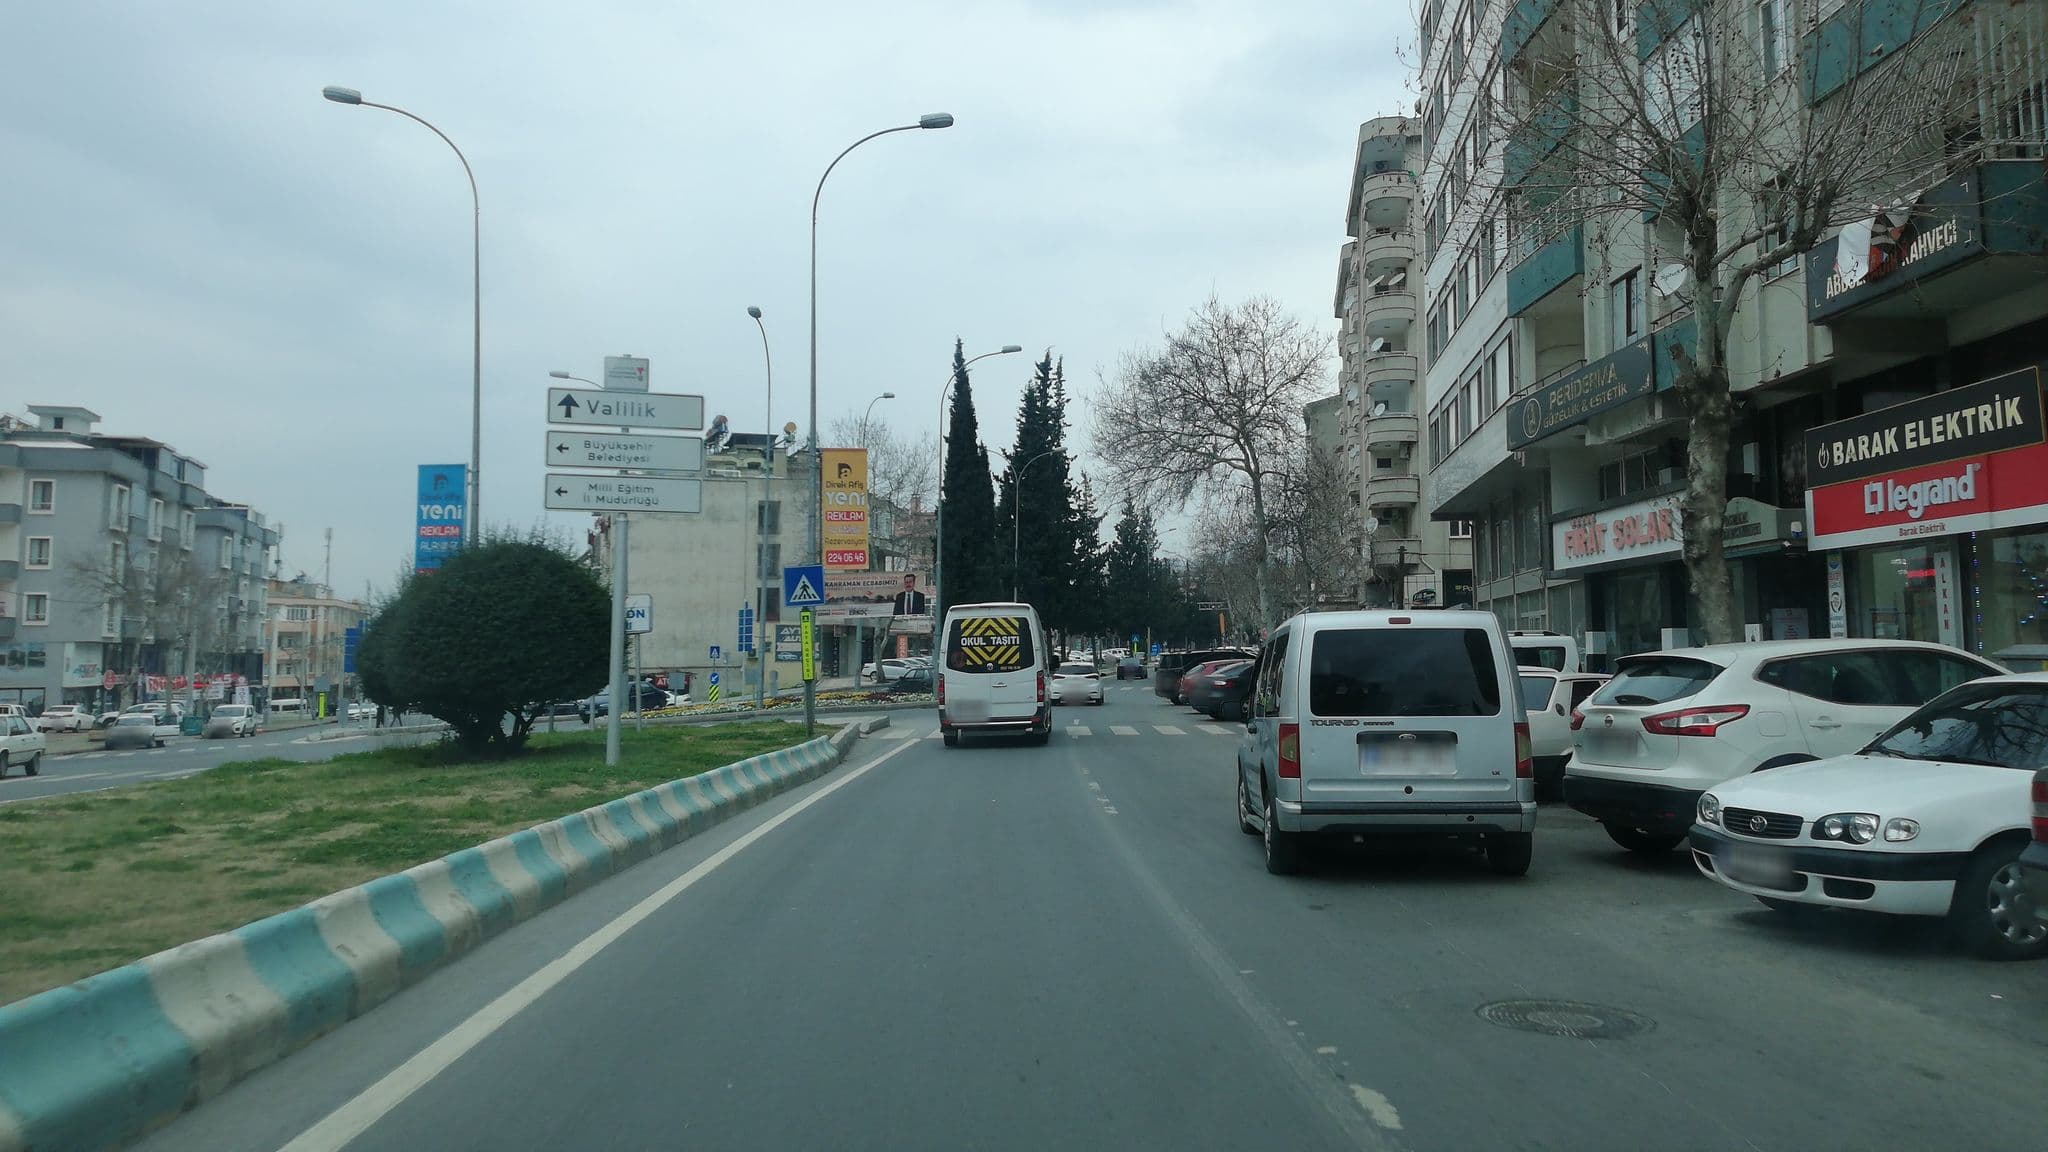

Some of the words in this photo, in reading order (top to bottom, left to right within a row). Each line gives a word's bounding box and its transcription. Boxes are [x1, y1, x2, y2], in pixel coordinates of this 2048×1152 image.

[586, 399, 656, 418] Valilik
[1833, 426, 1899, 466] BARAK
[1904, 393, 2024, 450] ELEKTRİK
[588, 452, 649, 464] Belediyesi
[618, 484, 654, 494] Eğitim
[1887, 463, 1976, 519] legrand
[826, 511, 864, 521] REKLAM
[420, 526, 460, 536] REKLAM
[1612, 507, 1674, 551] SOLAR
[1898, 524, 1918, 537] Barak
[1918, 521, 1946, 535] Elektrik
[827, 553, 843, 563] 224
[854, 552, 864, 562] 46
[960, 637, 986, 646] OKUL
[990, 635, 1020, 645] TAŞITI
